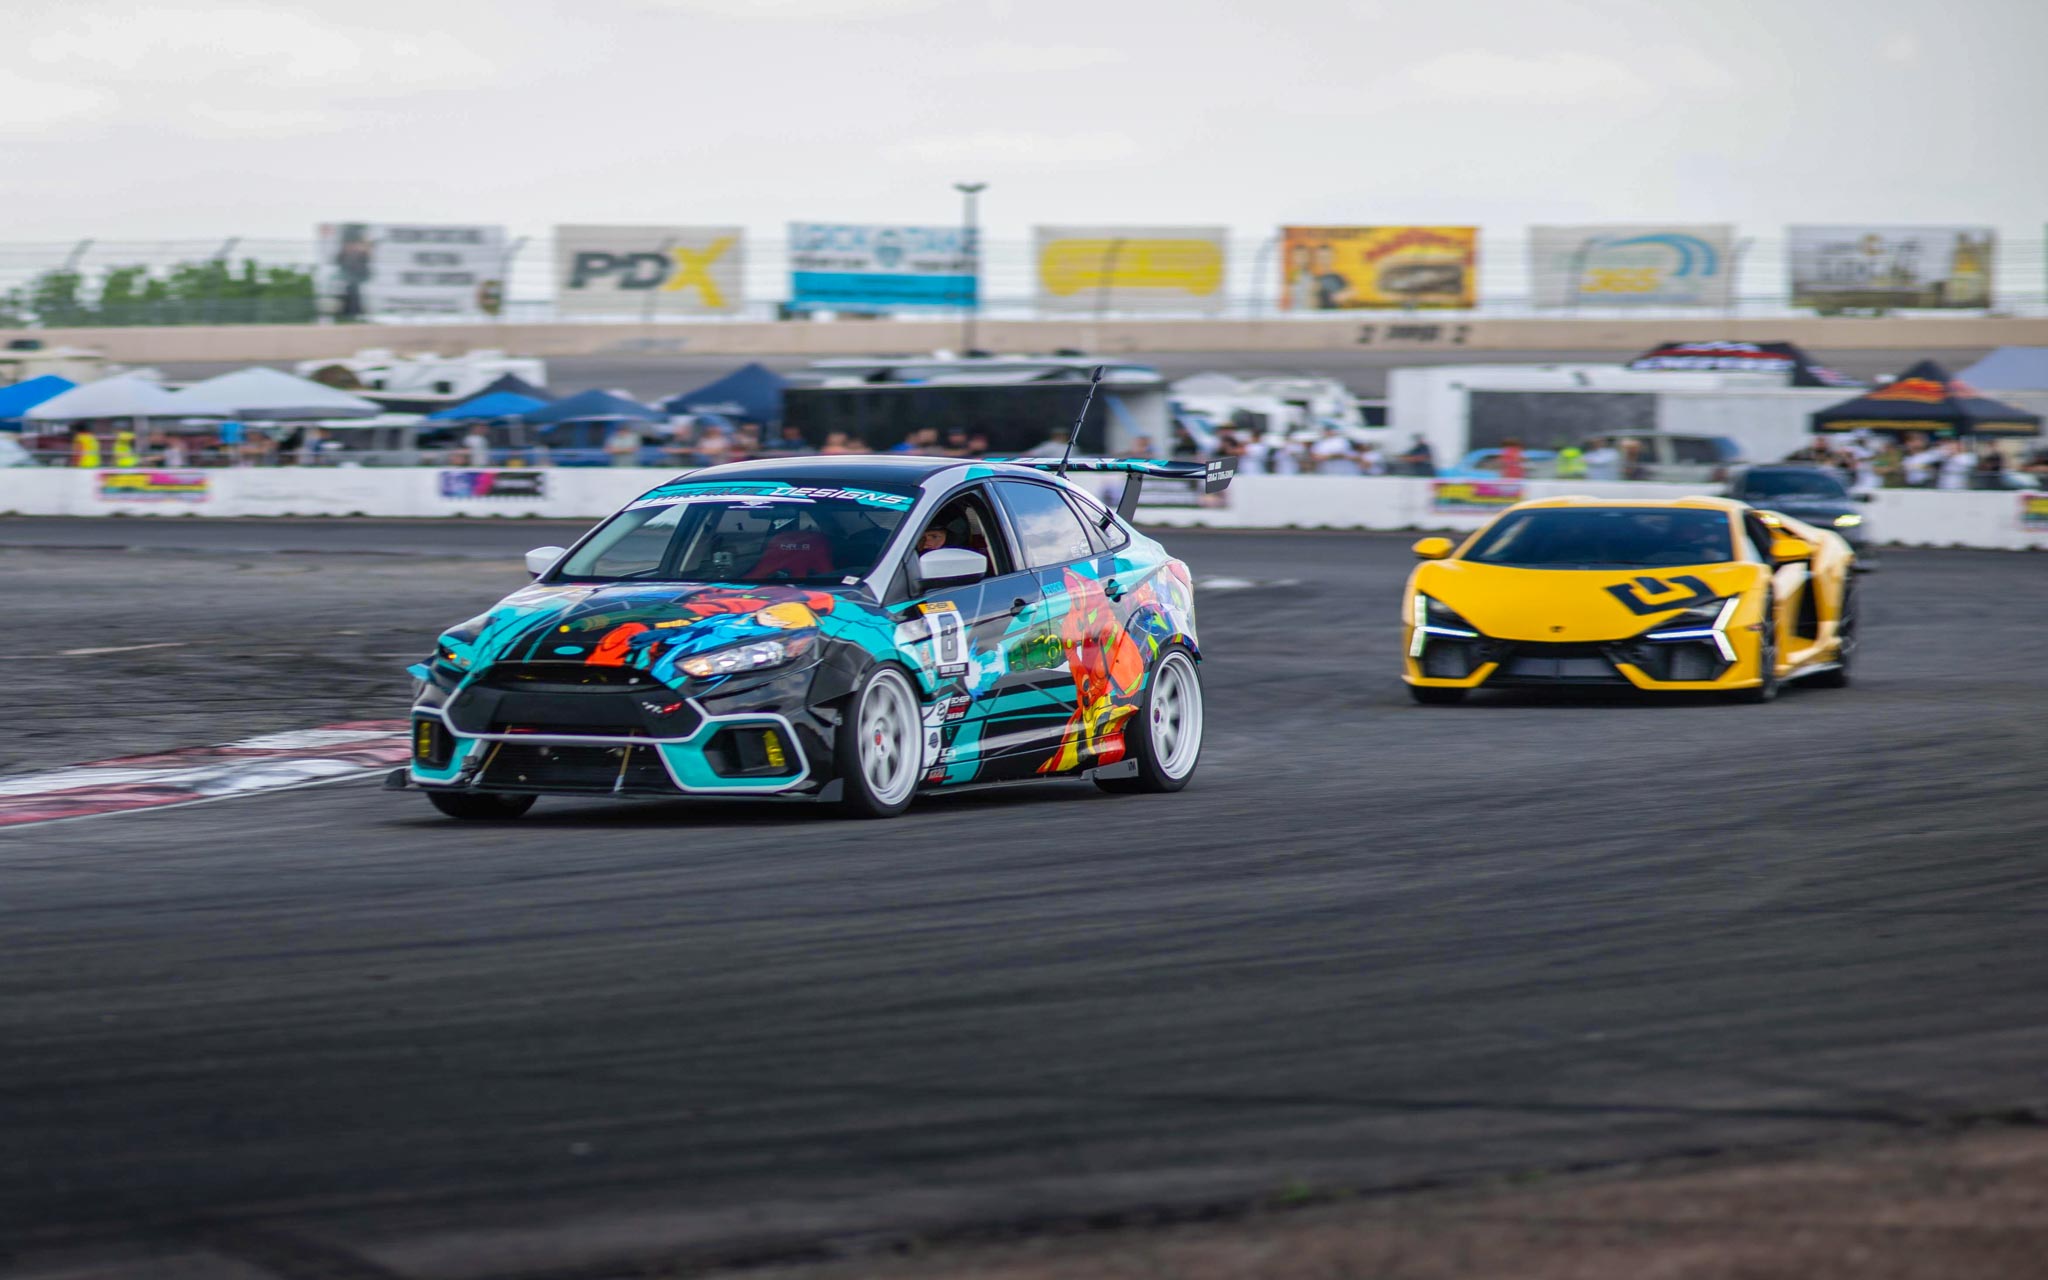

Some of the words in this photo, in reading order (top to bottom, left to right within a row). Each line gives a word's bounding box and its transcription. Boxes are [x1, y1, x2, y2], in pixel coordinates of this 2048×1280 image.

[568, 235, 738, 308] PDX
[767, 486, 909, 505] DESIGNS
[939, 614, 958, 662] 8
